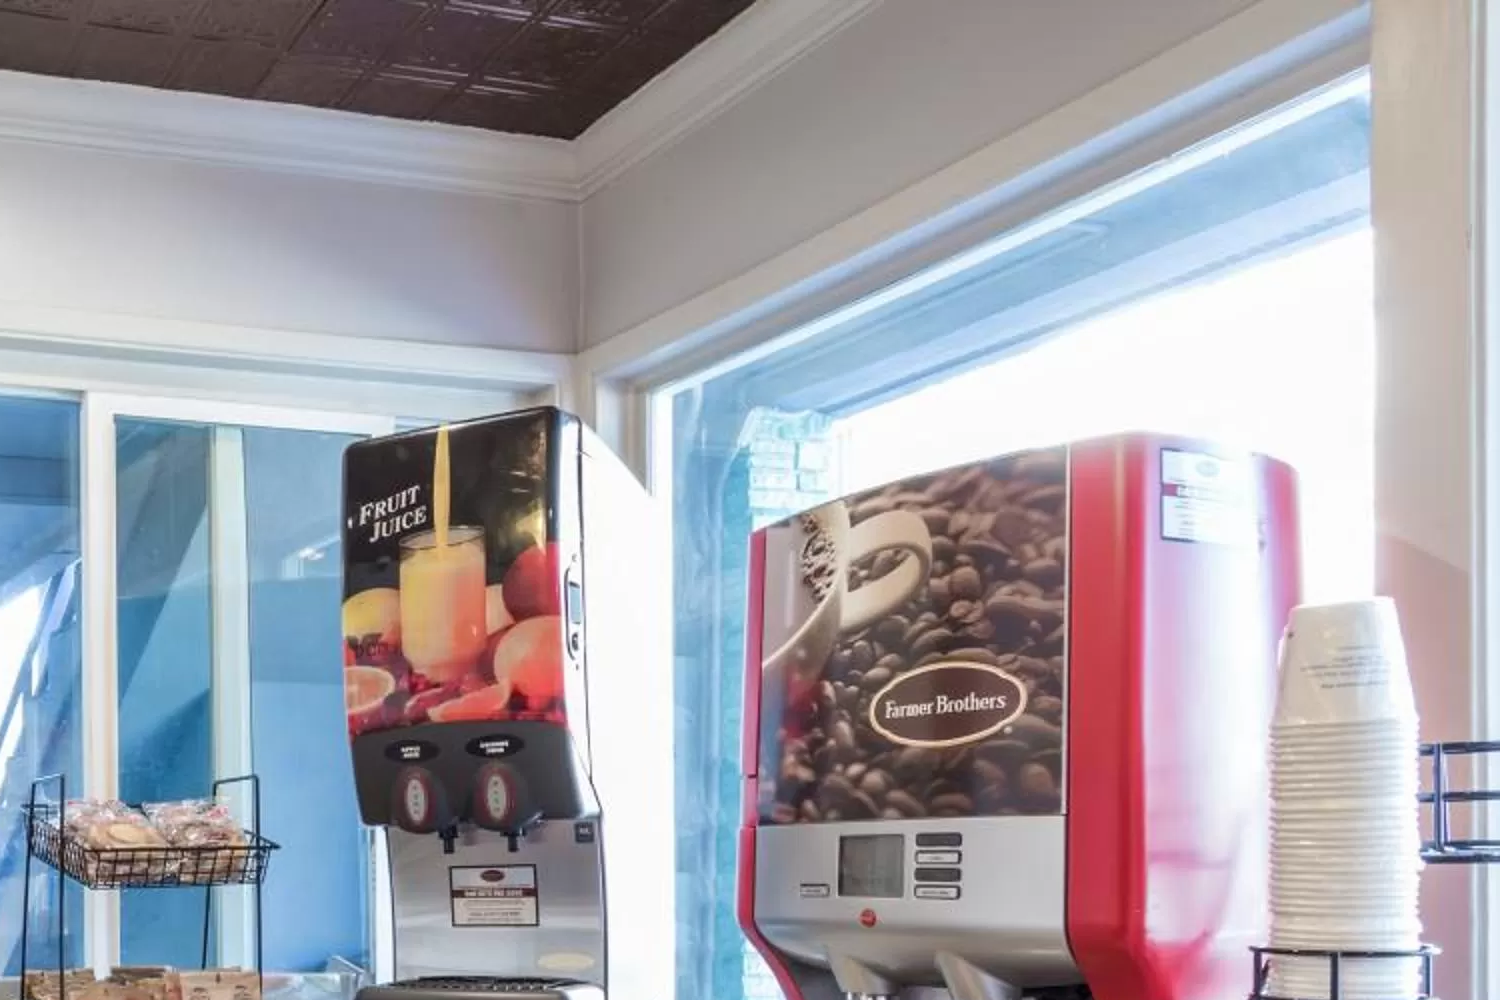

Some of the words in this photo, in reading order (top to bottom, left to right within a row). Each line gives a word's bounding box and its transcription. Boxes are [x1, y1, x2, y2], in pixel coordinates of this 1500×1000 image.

[359, 485, 421, 526] FRUIT
[369, 505, 427, 543] JUICE
[885, 700, 934, 719] Farmer
[936, 691, 1007, 714] Brothers
